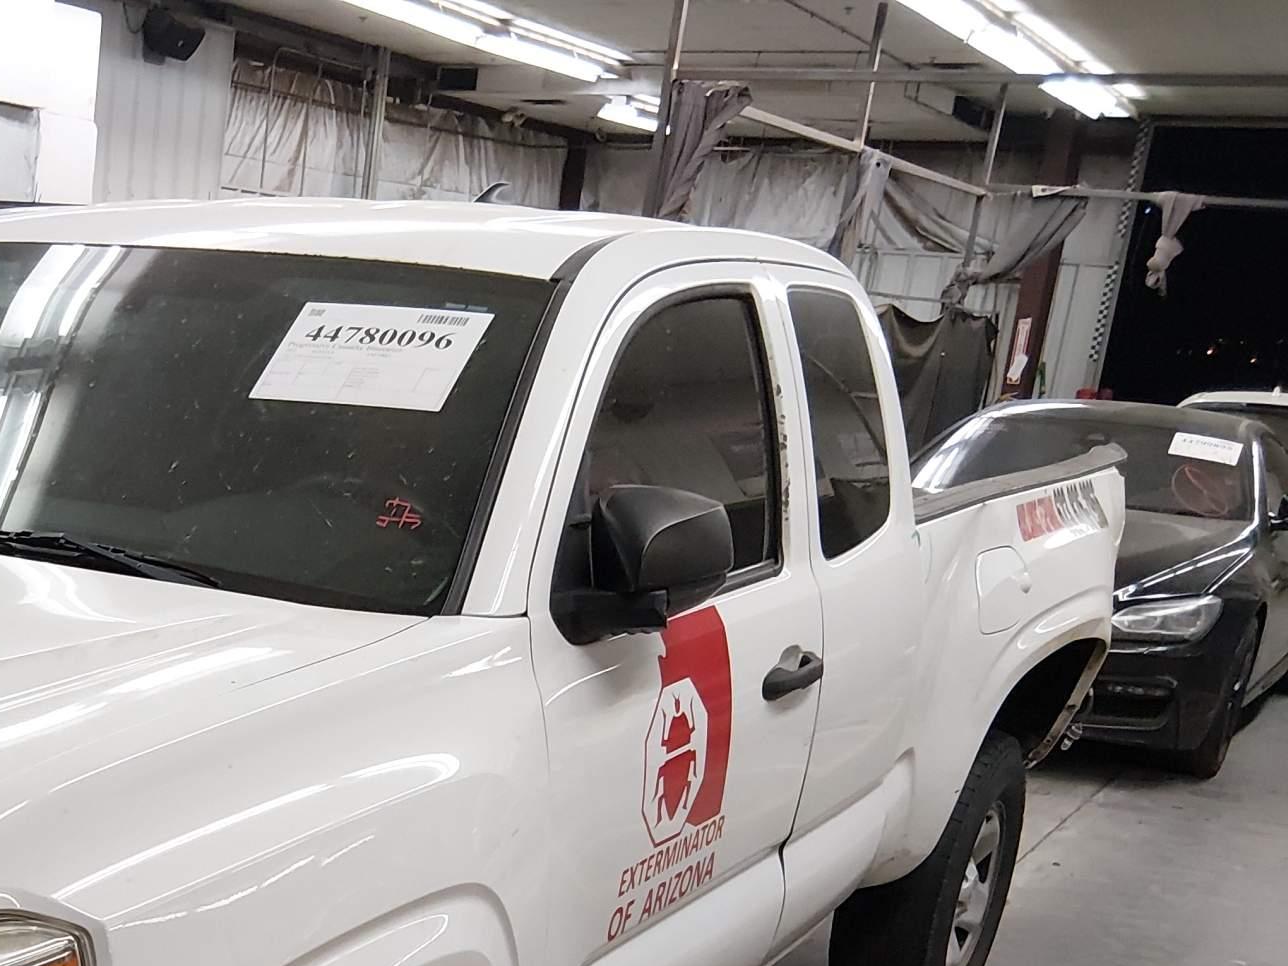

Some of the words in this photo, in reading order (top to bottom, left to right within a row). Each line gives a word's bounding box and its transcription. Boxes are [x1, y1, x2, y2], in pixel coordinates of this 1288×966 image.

[305, 324, 457, 351] 44780096
[607, 900, 635, 942] OF
[638, 852, 716, 925] ARIZONA
[617, 815, 725, 898] EXTERMINATOR
